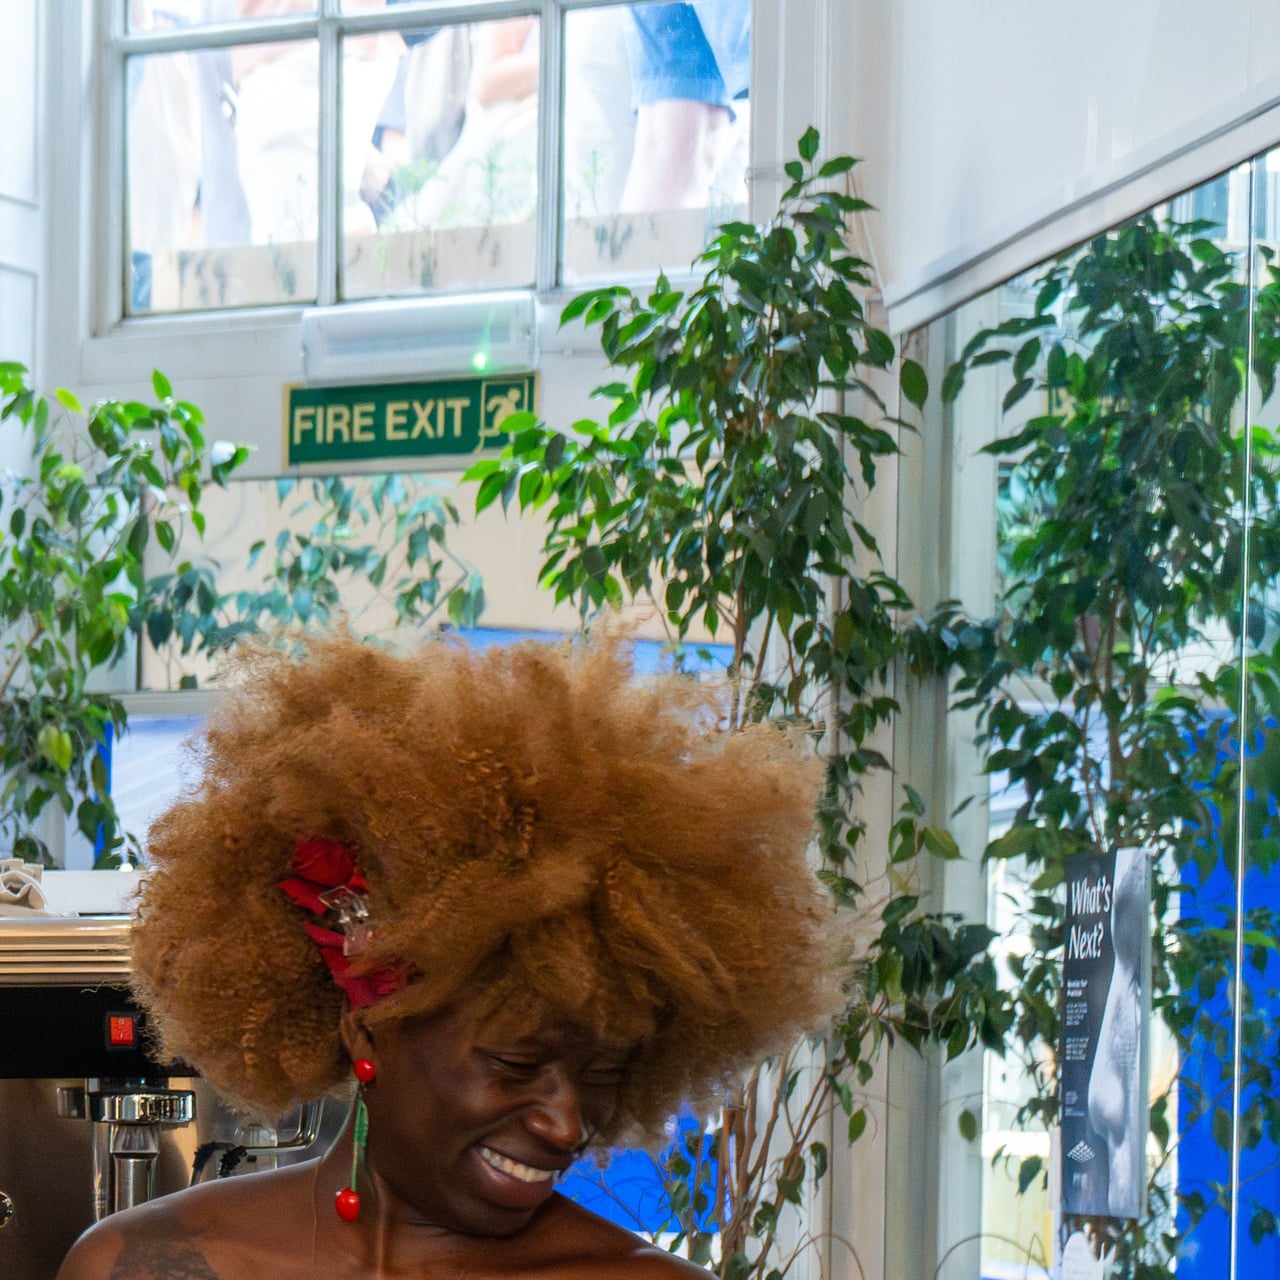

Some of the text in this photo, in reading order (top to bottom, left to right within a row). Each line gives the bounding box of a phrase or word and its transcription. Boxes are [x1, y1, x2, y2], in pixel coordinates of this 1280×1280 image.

[293, 397, 470, 445] FIRE EXIT
[1071, 875, 1111, 916] What's
[1068, 921, 1104, 960] Next?
